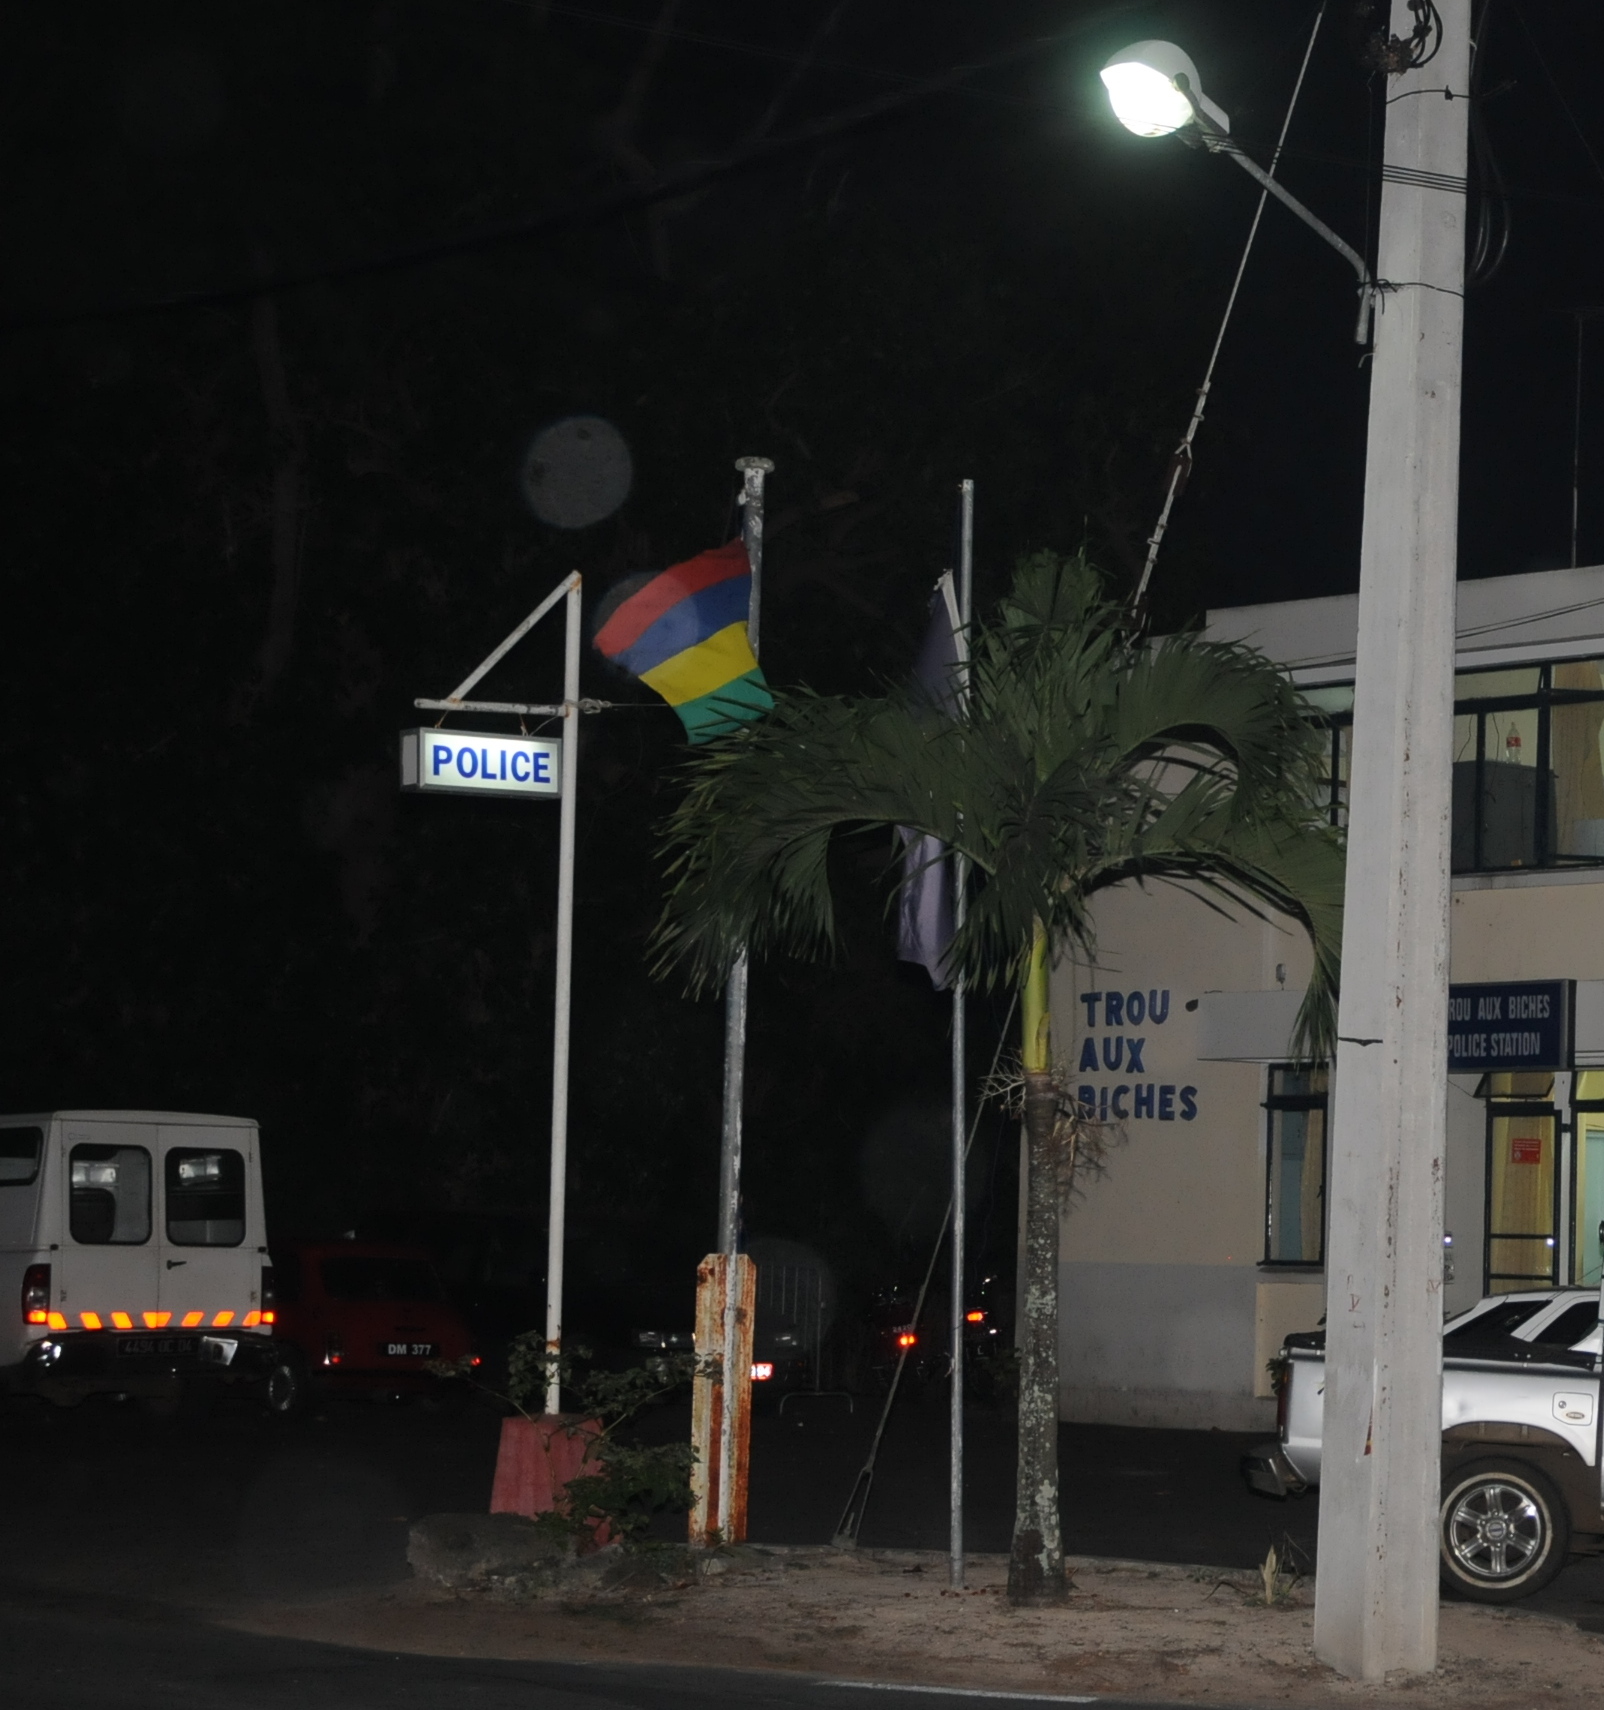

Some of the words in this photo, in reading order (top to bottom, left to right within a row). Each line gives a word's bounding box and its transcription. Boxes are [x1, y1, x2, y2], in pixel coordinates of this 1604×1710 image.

[433, 745, 551, 783] POLICE
[1080, 989, 1170, 1027] TROU
[1448, 998, 1471, 1021] ROU
[1478, 997, 1501, 1020] AUX
[1508, 995, 1550, 1019] BICHES
[1079, 1036, 1146, 1073] AUX
[1448, 1033, 1487, 1058] POLICE
[1490, 1032, 1540, 1057] STATION
[1078, 1083, 1198, 1121] BICHES
[387, 1343, 407, 1355] DM
[411, 1344, 432, 1355] 377
